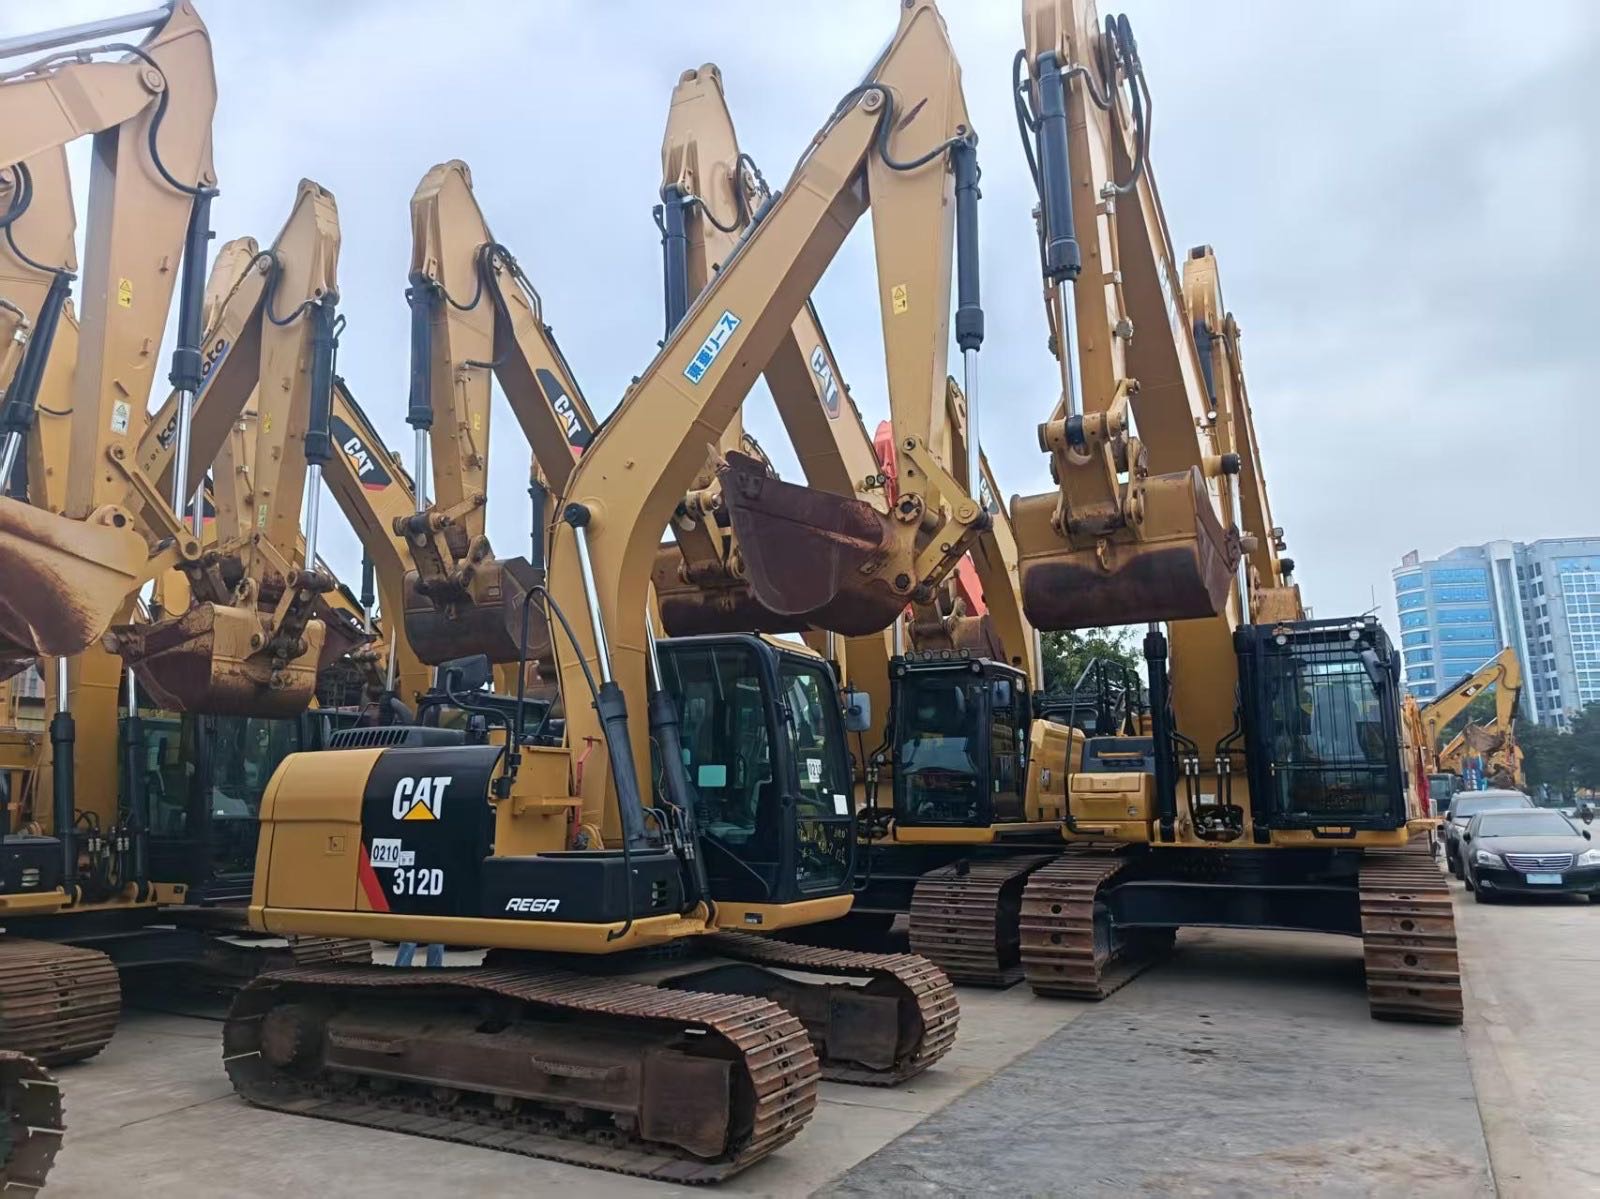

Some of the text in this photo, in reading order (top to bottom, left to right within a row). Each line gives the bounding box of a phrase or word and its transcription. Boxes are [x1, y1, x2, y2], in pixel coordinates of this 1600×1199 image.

[809, 344, 837, 402] CAT
[553, 394, 581, 438] CAT
[343, 437, 374, 477] CAT
[392, 776, 452, 820] CAT
[372, 845, 399, 861] 0210
[392, 868, 444, 896] 312D
[505, 898, 560, 912] REGA
